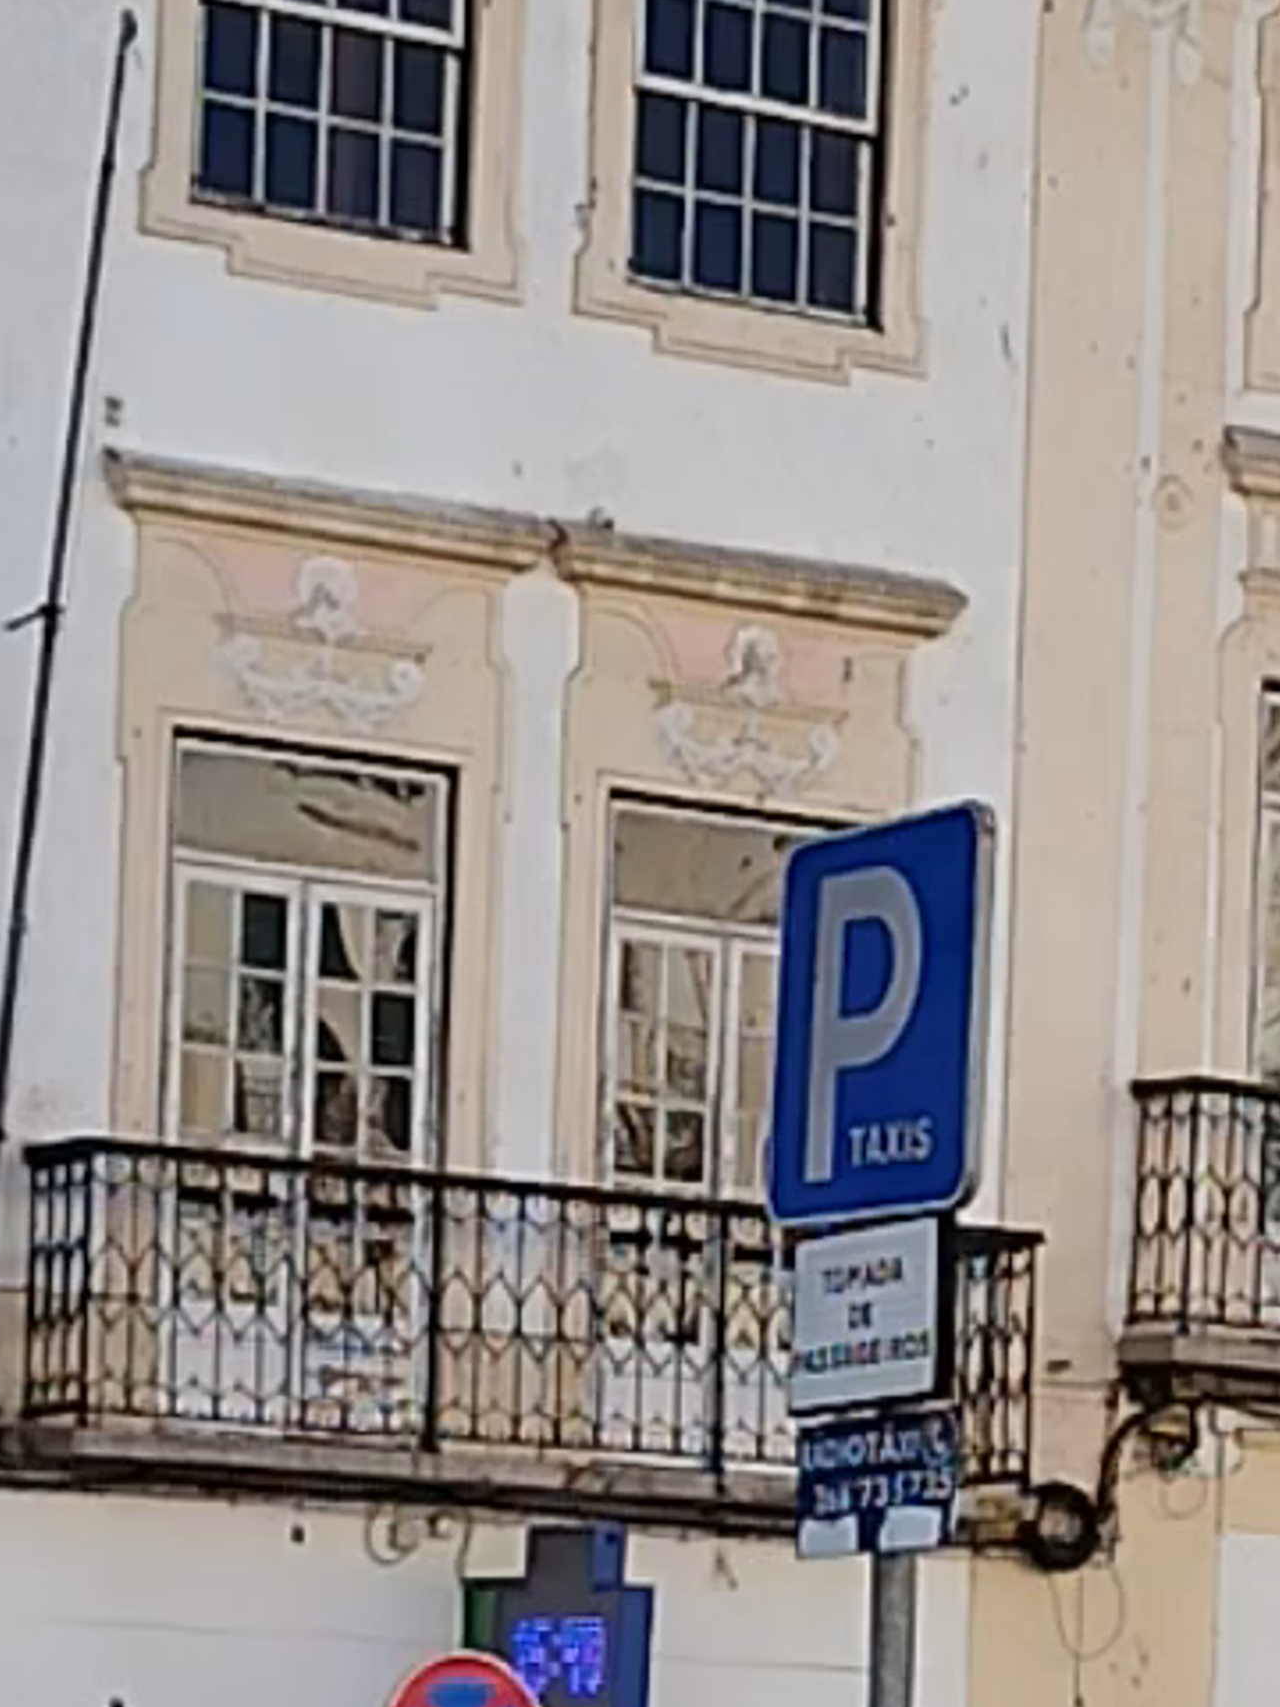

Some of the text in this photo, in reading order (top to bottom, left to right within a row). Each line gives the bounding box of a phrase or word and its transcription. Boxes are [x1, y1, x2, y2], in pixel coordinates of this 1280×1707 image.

[803, 865, 923, 1183] P
[848, 1117, 933, 1168] TAXIS
[822, 1255, 904, 1294] TOMADA
[848, 1303, 872, 1330] DE
